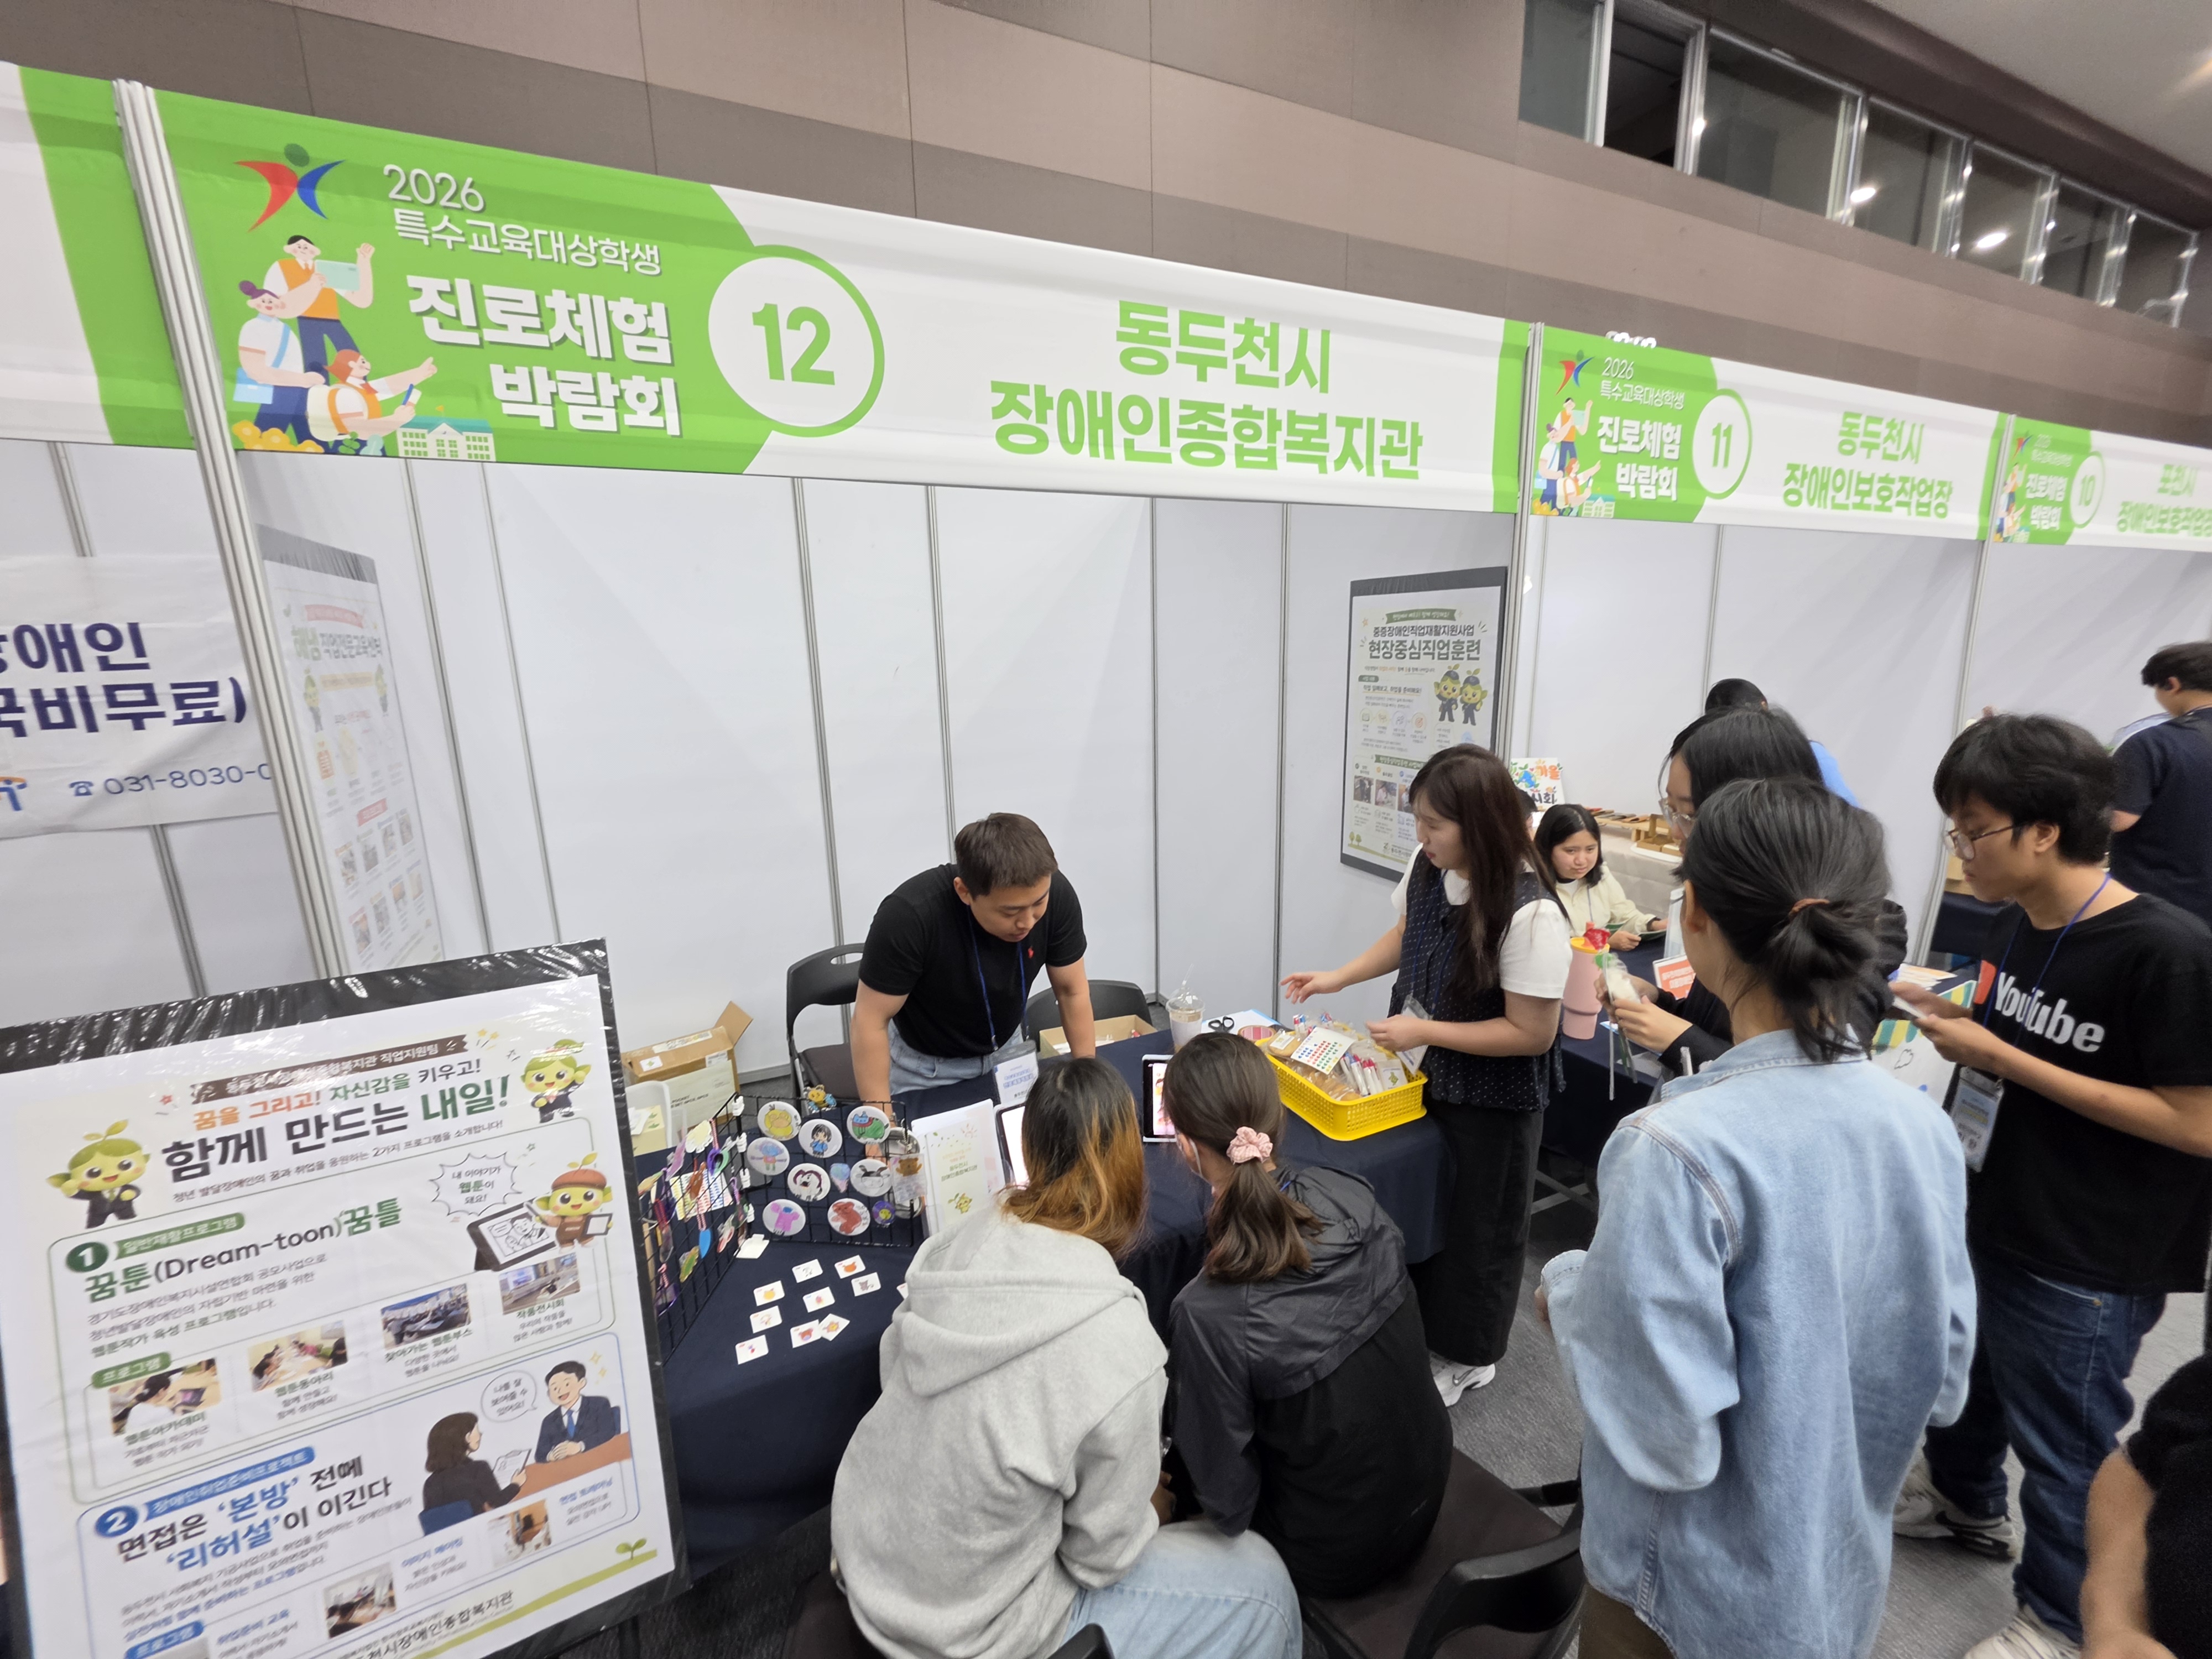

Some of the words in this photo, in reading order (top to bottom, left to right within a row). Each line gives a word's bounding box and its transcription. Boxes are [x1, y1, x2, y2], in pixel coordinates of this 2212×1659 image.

[383, 164, 486, 211] 2026
[394, 208, 662, 276] 특수교육대상학생
[406, 274, 673, 364] 진로체험
[752, 303, 835, 385] 12
[1117, 300, 1331, 394] 동두천시
[1602, 357, 1634, 379] 2026
[489, 364, 680, 436] 박람회
[1600, 380, 1684, 410] 특수교육대상학생
[990, 380, 1423, 479] 장애인종합복지관
[1597, 415, 1682, 460] 진로체험
[1712, 422, 1733, 469] 11
[1838, 411, 1924, 463] 동두천시
[1615, 463, 1678, 500] 박람회
[1782, 463, 1953, 519] 장애인보호작업장
[0, 623, 150, 674] 애인
[1369, 639, 1481, 661] 현장중심직업훈련
[1535, 765, 1560, 780] 가을
[1994, 972, 2105, 1052] YouTube
[380, 1043, 439, 1065] 직업지원팀
[193, 1104, 240, 1131] 꿈을
[248, 1089, 321, 1119] 그리고!
[329, 1072, 410, 1104] 자신감을
[418, 1057, 482, 1085] 키우고!
[161, 1123, 267, 1185] 함께
[285, 1096, 410, 1156] 만드는
[420, 1074, 512, 1125] 내일!
[173, 1189, 196, 1204] 청년
[199, 1173, 265, 1198] 발달장애인의
[269, 1167, 291, 1182] 꿈과
[294, 1159, 326, 1176] 취업을
[372, 1142, 400, 1157] 2가지
[403, 1131, 451, 1150] 프로그램을
[453, 1119, 503, 1139] 소개합니다!
[465, 1166, 502, 1178] 이야기가
[458, 1179, 494, 1193] 웹툰이
[78, 1246, 95, 1268] 1
[292, 1271, 315, 1286] 위한
[101, 1356, 161, 1384] 프로그램
[105, 1508, 129, 1534] 2
[117, 1511, 208, 1564] 면접은
[309, 1454, 363, 1493] 전에
[316, 1474, 393, 1522] 이긴다
